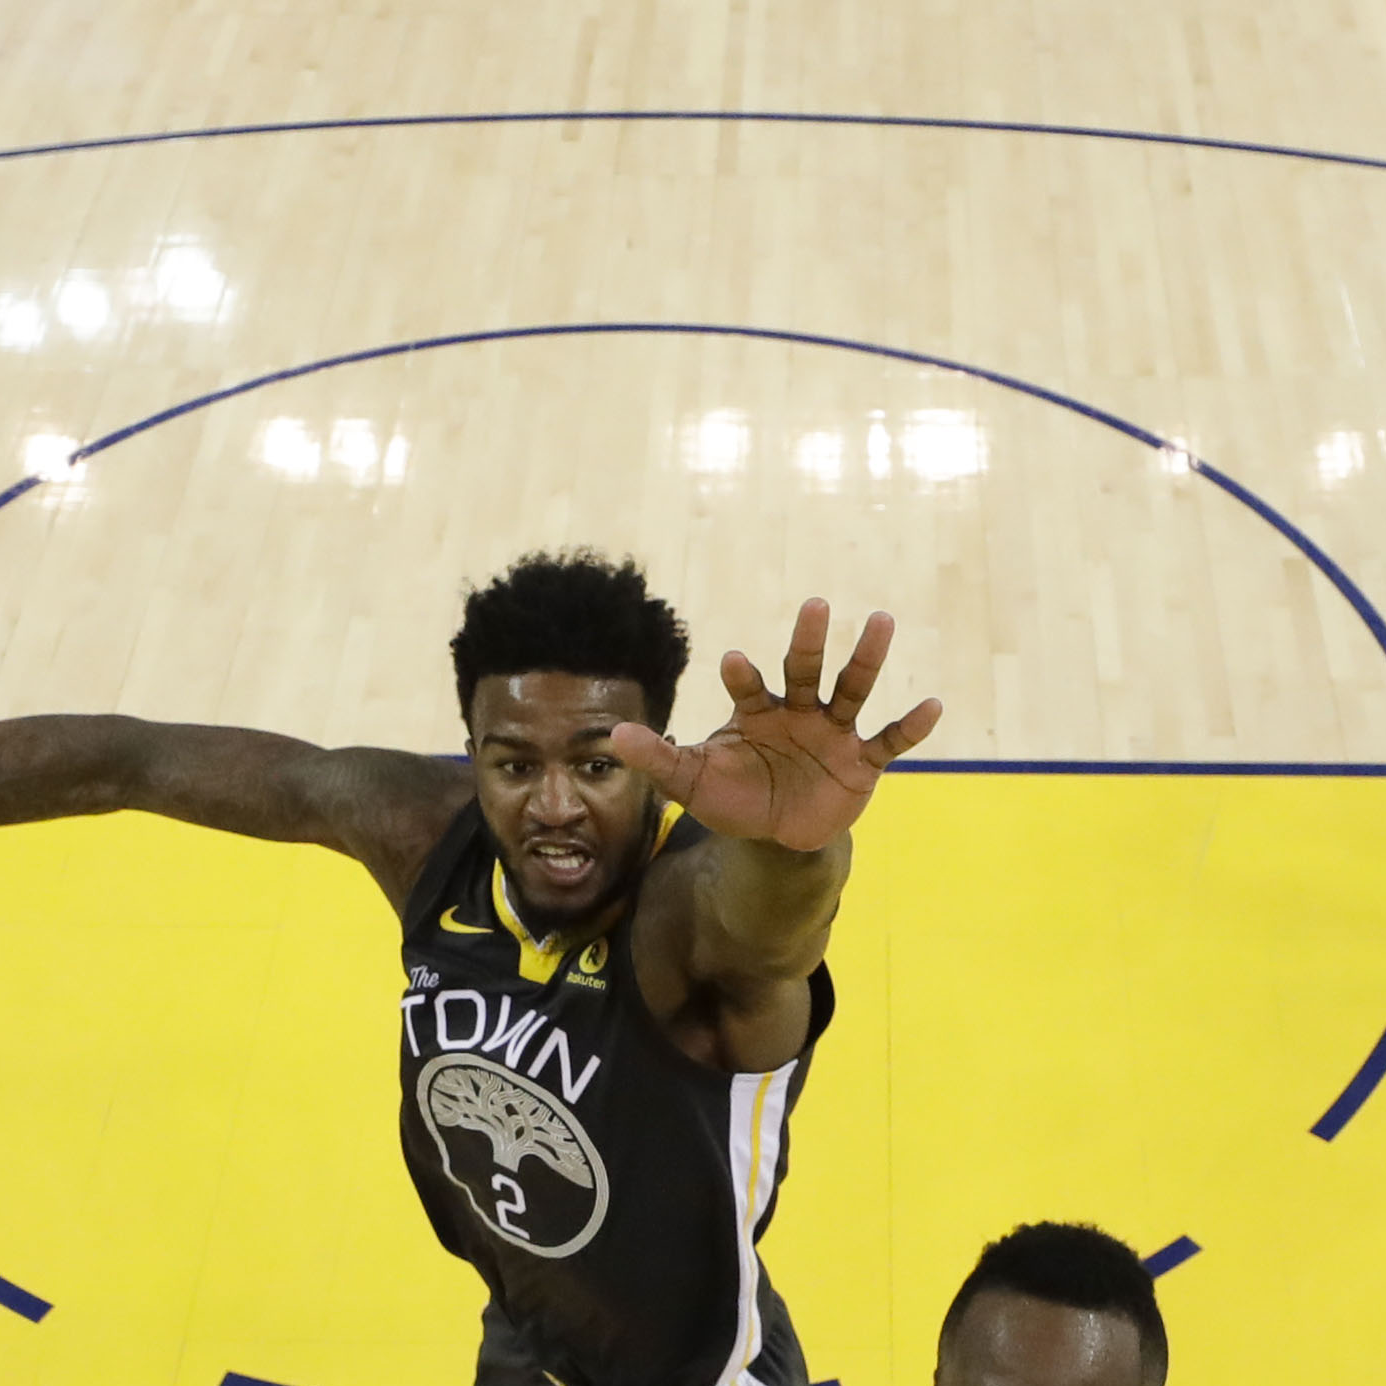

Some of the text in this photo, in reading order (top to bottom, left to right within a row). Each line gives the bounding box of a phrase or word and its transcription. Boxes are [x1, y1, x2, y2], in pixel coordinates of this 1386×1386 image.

[409, 965, 439, 991] The
[565, 971, 606, 991] Rakuten
[400, 988, 602, 1105] TOWN
[491, 1172, 531, 1240] 2
